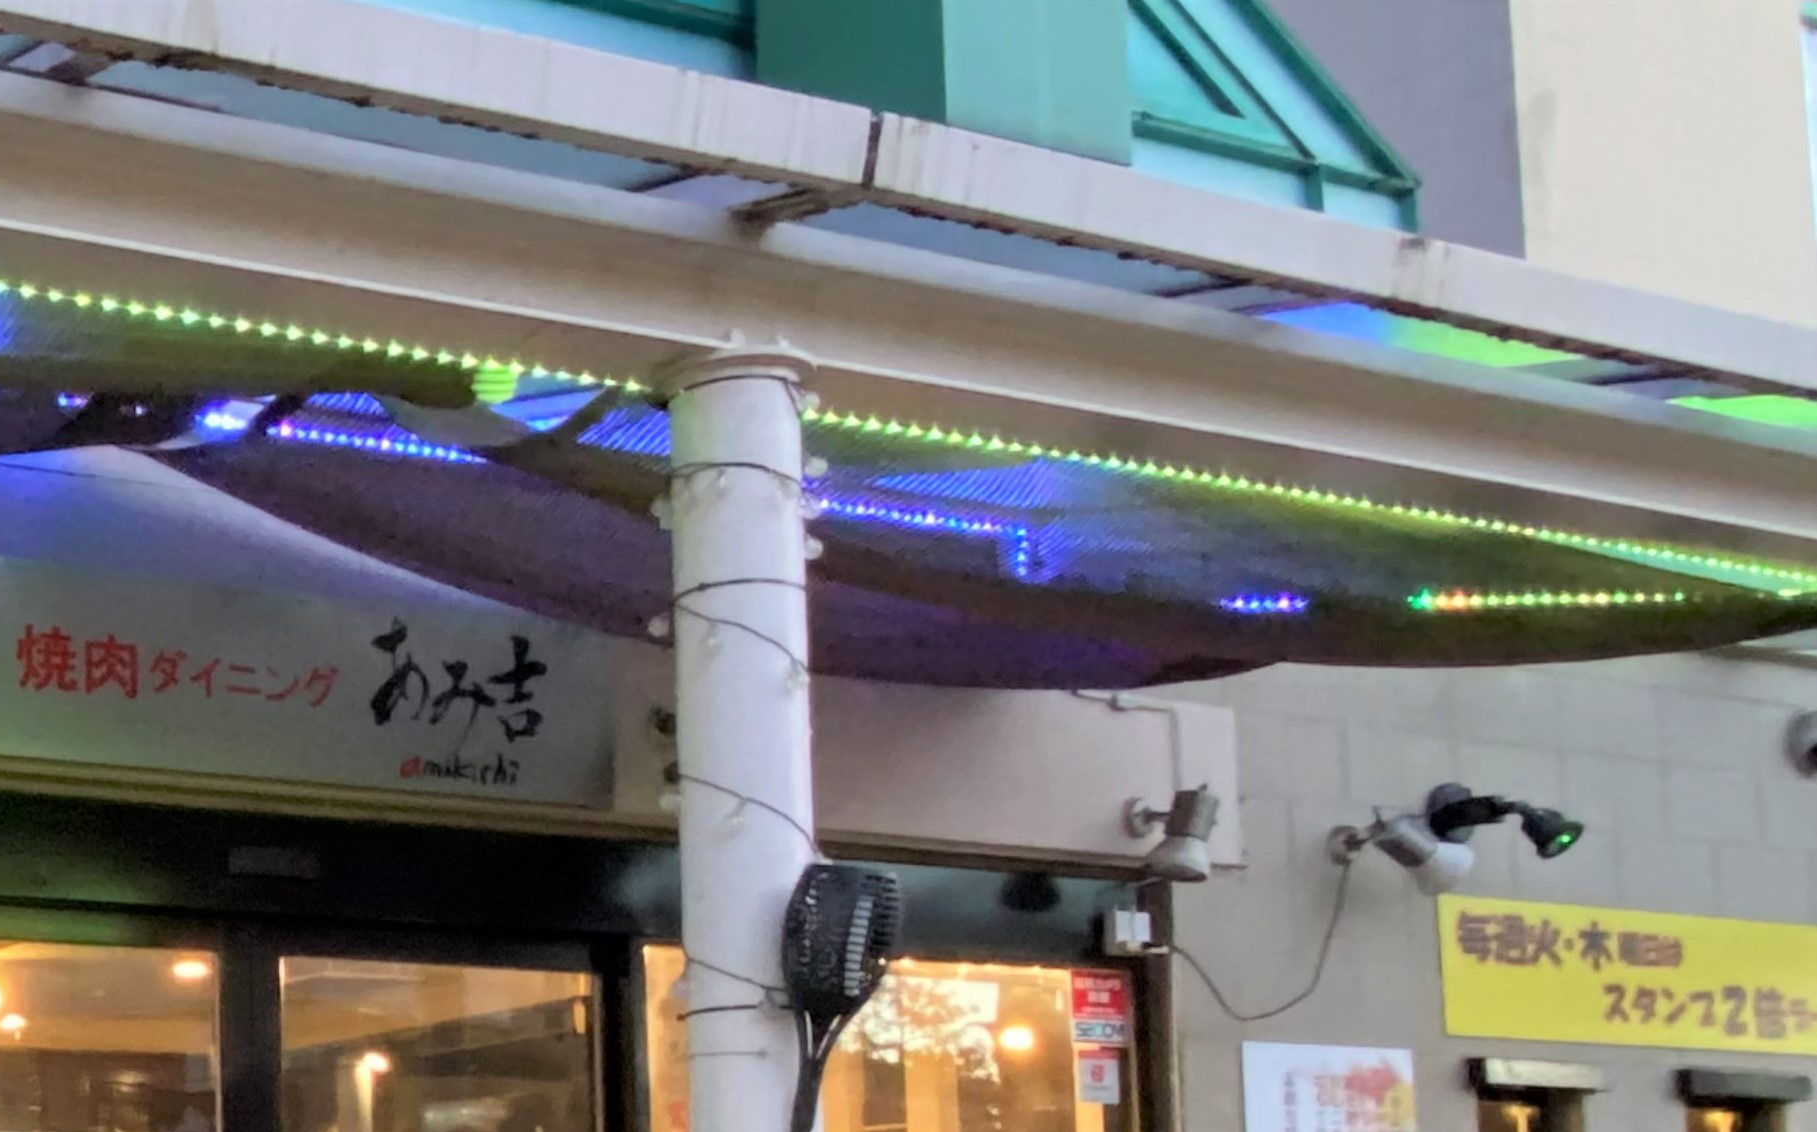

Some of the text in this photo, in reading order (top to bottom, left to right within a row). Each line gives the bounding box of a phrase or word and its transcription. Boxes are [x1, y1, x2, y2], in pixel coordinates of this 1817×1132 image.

[15, 616, 548, 743] 焼肉ダイニング あみ吉
[1075, 1021, 1127, 1038] SECOM
